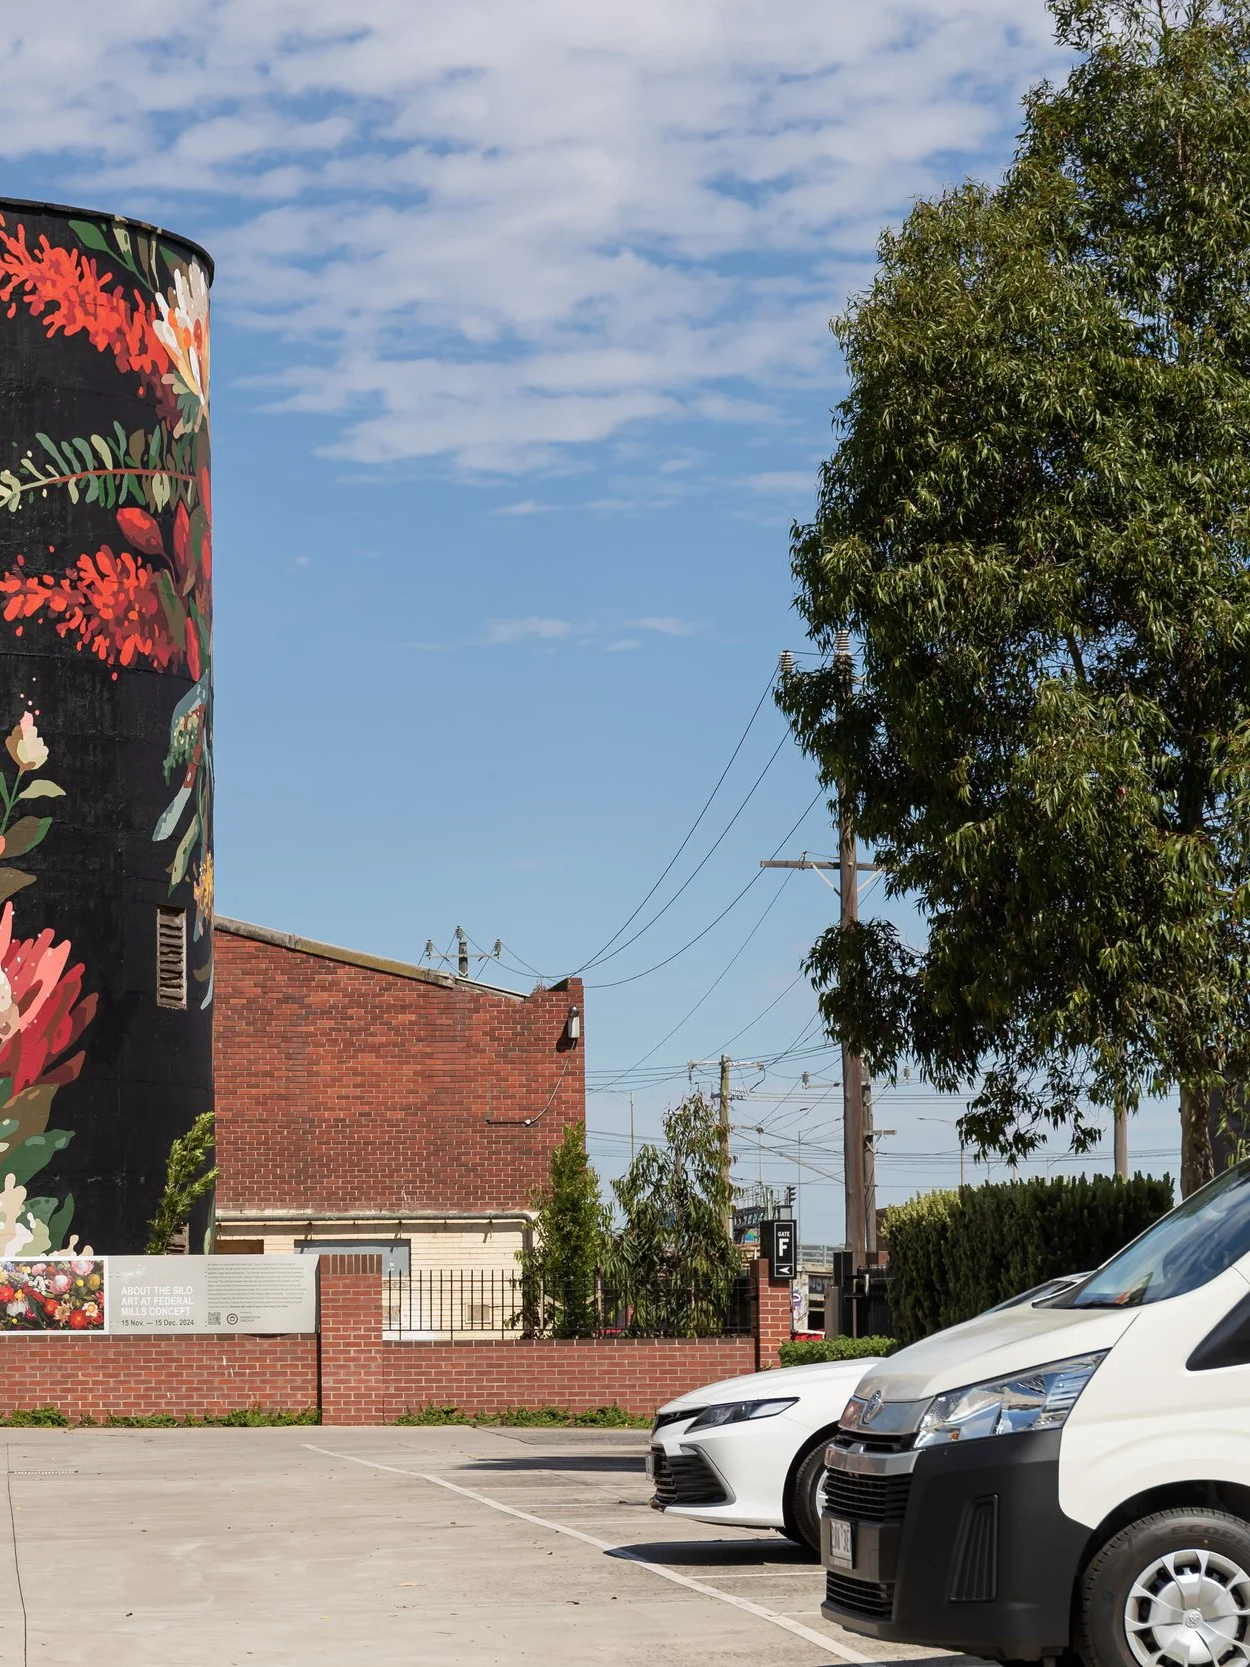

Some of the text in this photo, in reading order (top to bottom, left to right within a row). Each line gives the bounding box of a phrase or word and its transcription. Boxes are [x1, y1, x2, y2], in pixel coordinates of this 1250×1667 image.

[779, 1239, 789, 1257] F
[121, 1286, 193, 1295] ABOUT THE SILO
[121, 1296, 194, 1306] ART AT FEDERAL
[121, 1307, 190, 1316] MILLS CONCEPT
